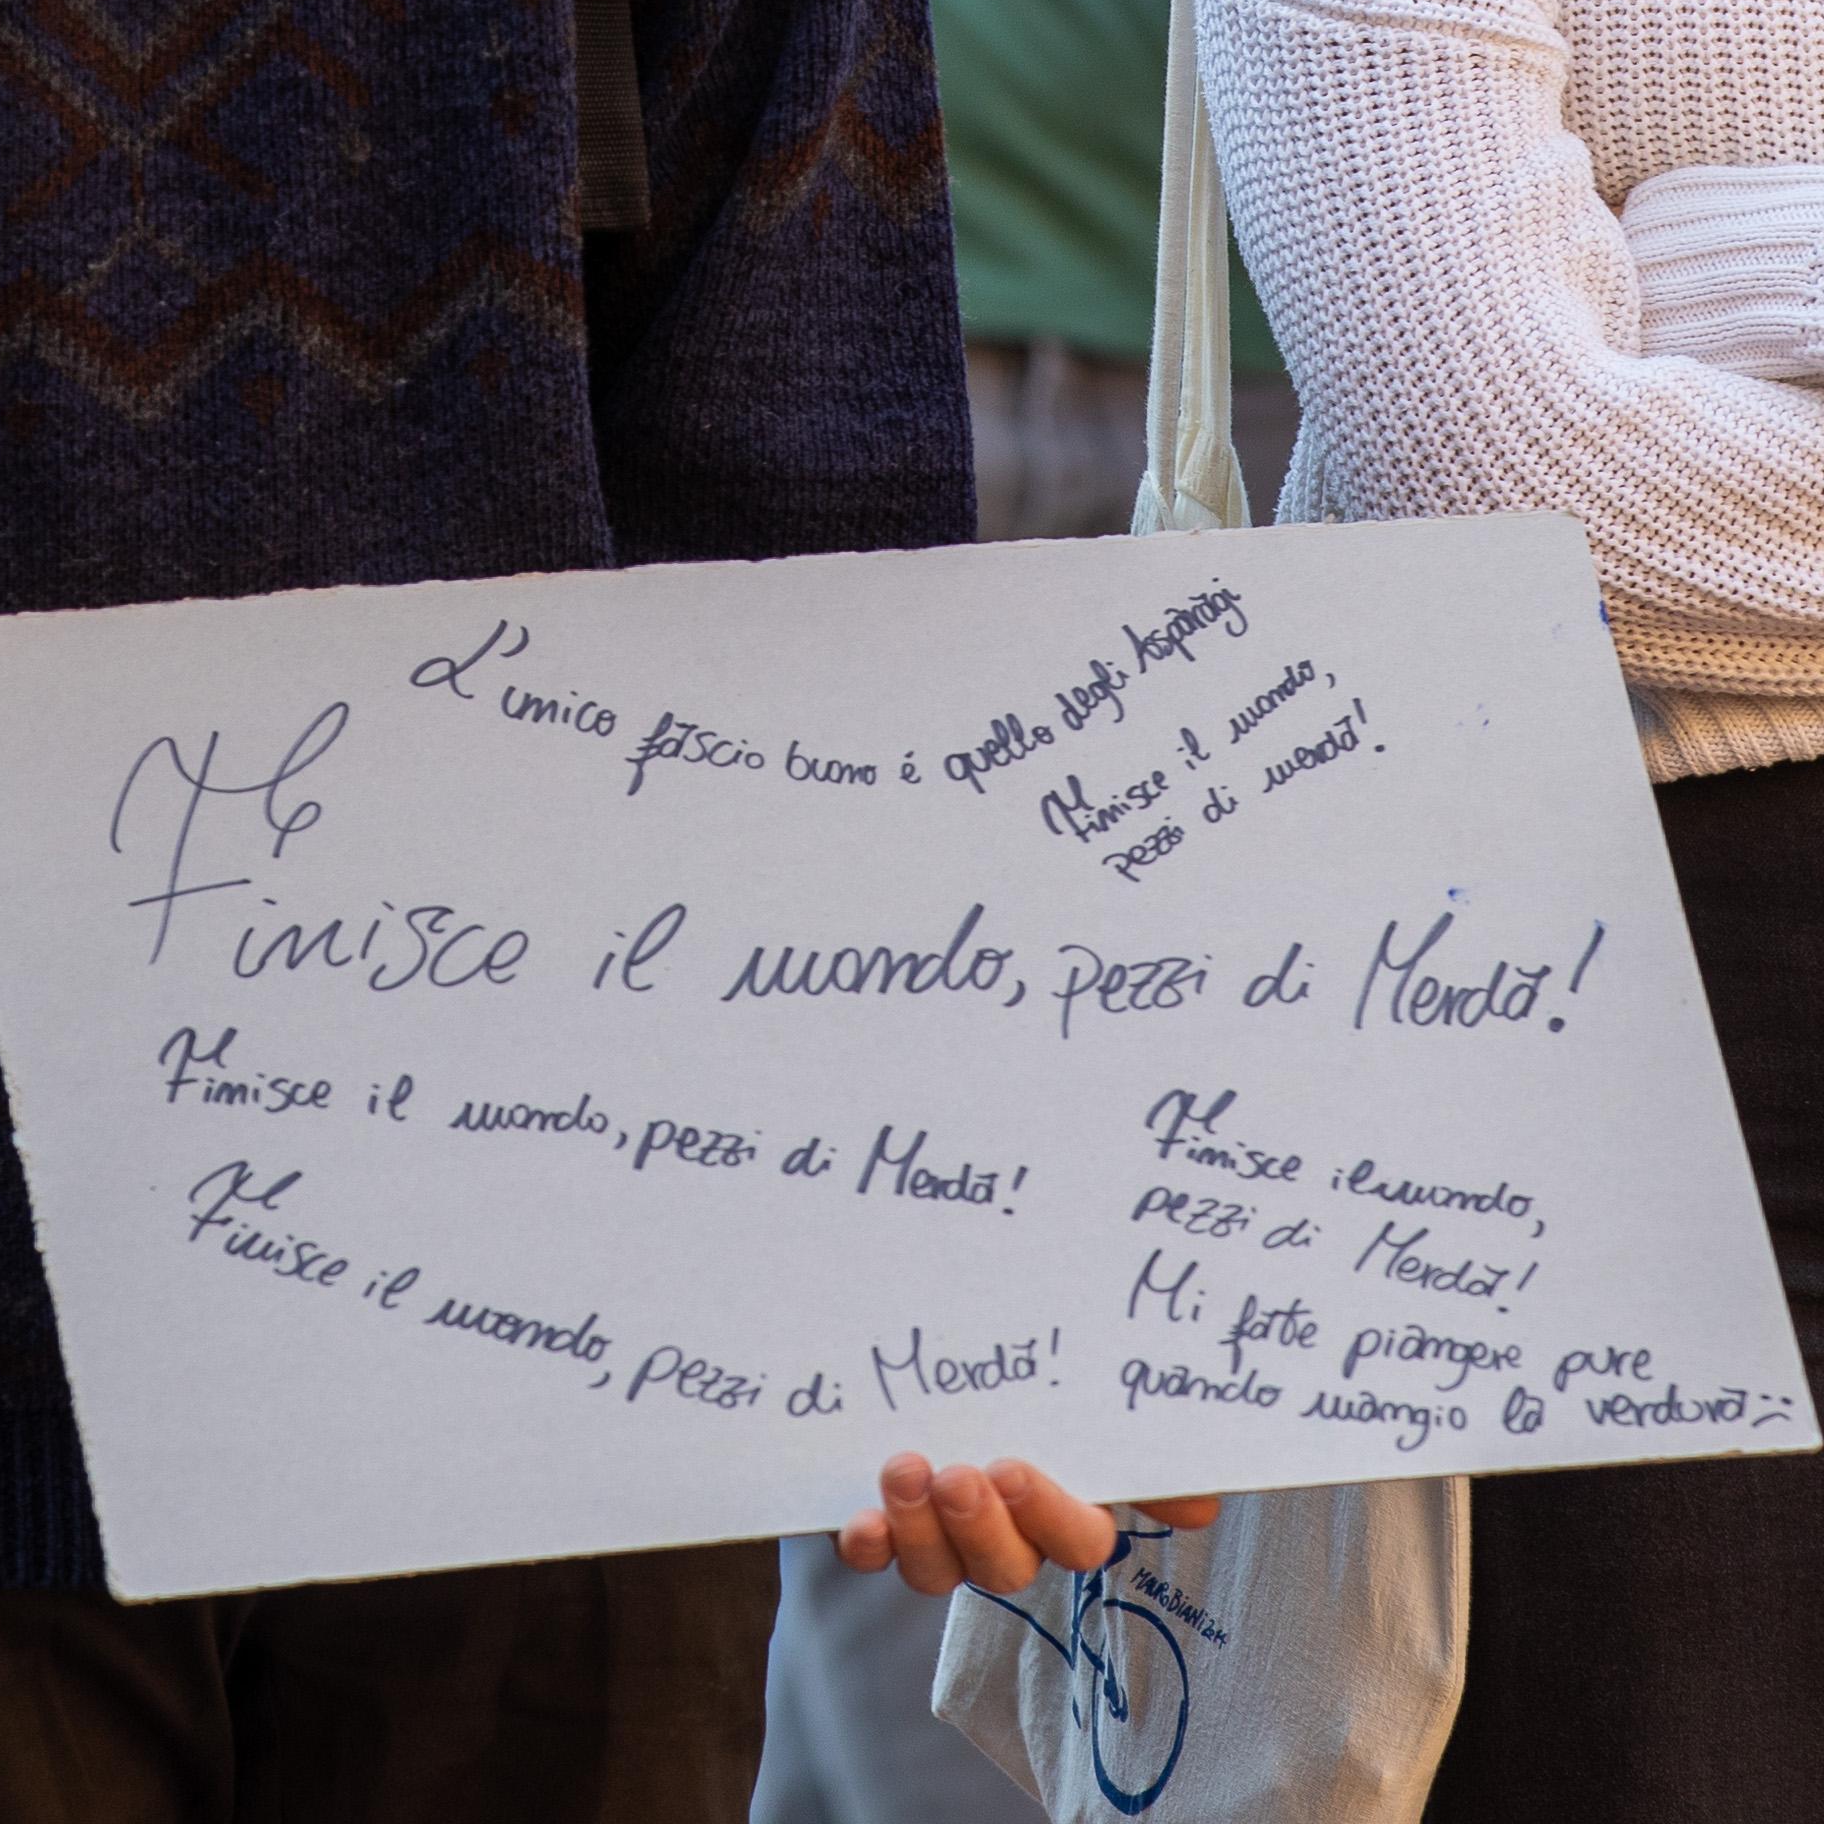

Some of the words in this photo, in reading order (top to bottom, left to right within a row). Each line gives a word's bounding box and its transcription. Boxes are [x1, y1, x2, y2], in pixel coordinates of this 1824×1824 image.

[410, 618, 618, 737] L'unico
[625, 711, 766, 797] fascio
[785, 740, 879, 786] buono
[943, 712, 1056, 795] quello
[1055, 659, 1130, 724] degli
[1176, 727, 1211, 770] il
[1102, 816, 1187, 883] pezzi
[1202, 785, 1239, 825] di
[593, 901, 688, 993] il
[1052, 944, 1213, 1040] pezzi
[1244, 941, 1322, 1010] di
[1353, 910, 1607, 1036] Merda!
[367, 1073, 414, 1122] il
[632, 1119, 763, 1171] pezzi
[781, 1136, 838, 1178] di
[856, 1124, 1030, 1216] Merda!
[1130, 1185, 1258, 1239] pezzi
[1262, 1218, 1322, 1250] di
[1354, 1220, 1540, 1314] Merda!
[362, 1267, 422, 1310] il
[626, 1344, 768, 1411] pezzi
[787, 1372, 845, 1417] di
[872, 1326, 1060, 1412] Merda!
[1127, 1248, 1207, 1323] Mi
[1219, 1294, 1318, 1375] fate
[1342, 1325, 1524, 1392] piangere
[1553, 1346, 1654, 1393] pure
[1120, 1358, 1283, 1411] quando
[1301, 1390, 1468, 1452] mangio
[1502, 1386, 1546, 1435] la
[1586, 1383, 1748, 1429] verdura
